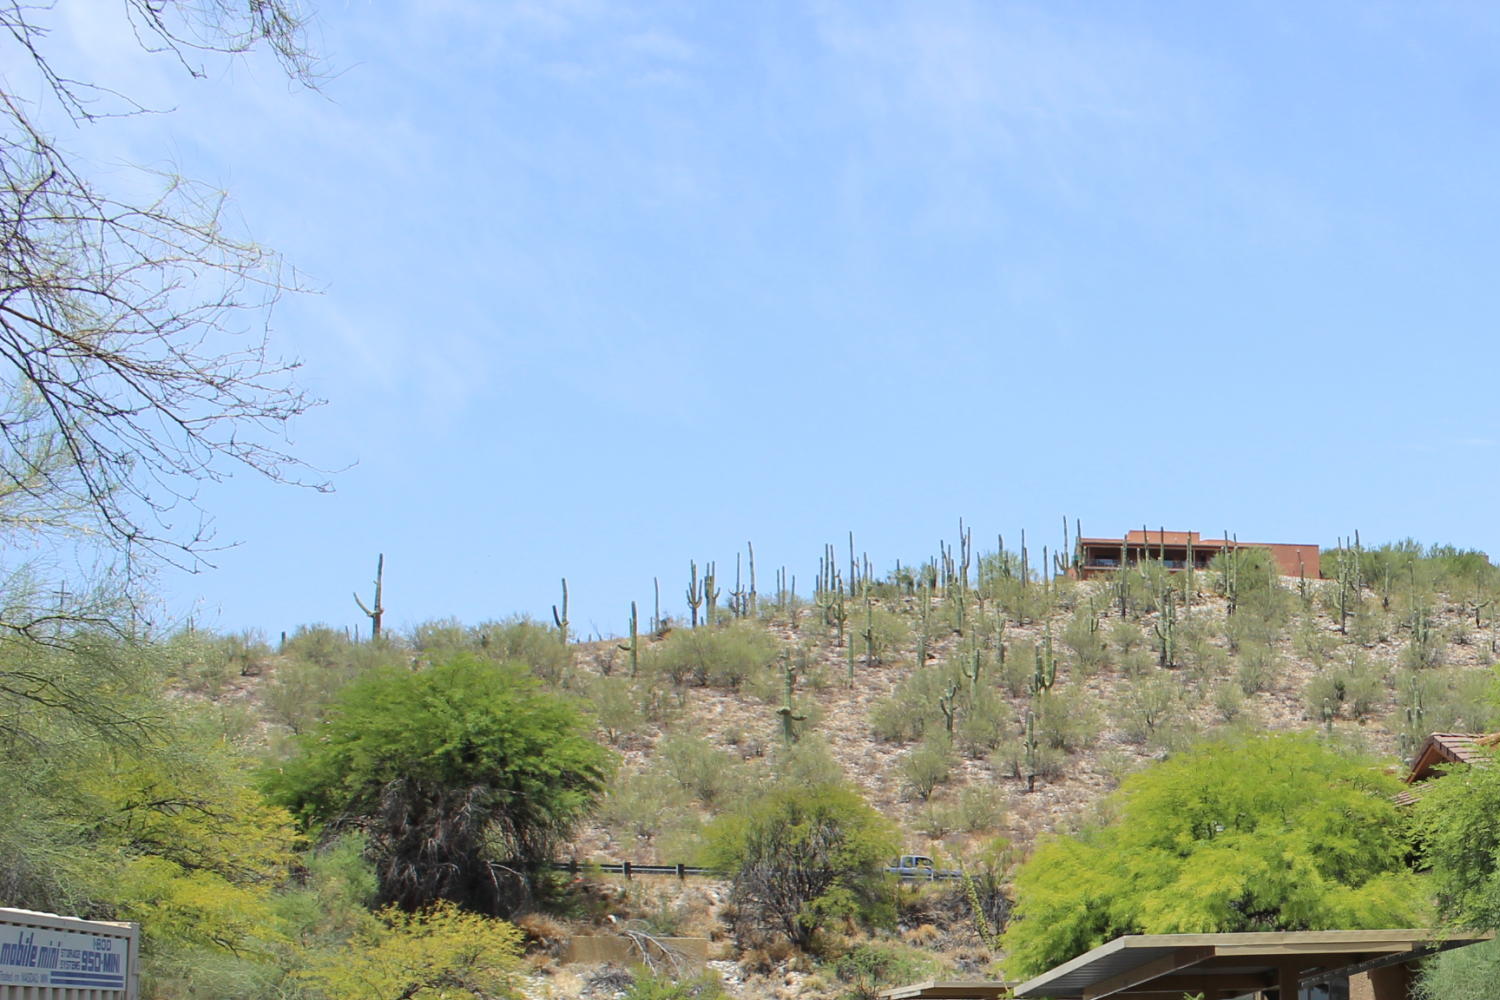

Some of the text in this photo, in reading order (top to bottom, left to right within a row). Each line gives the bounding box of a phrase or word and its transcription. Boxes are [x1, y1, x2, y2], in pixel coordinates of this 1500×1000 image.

[0, 931, 61, 969] mobile mini
[81, 951, 120, 973] 950-MINI
